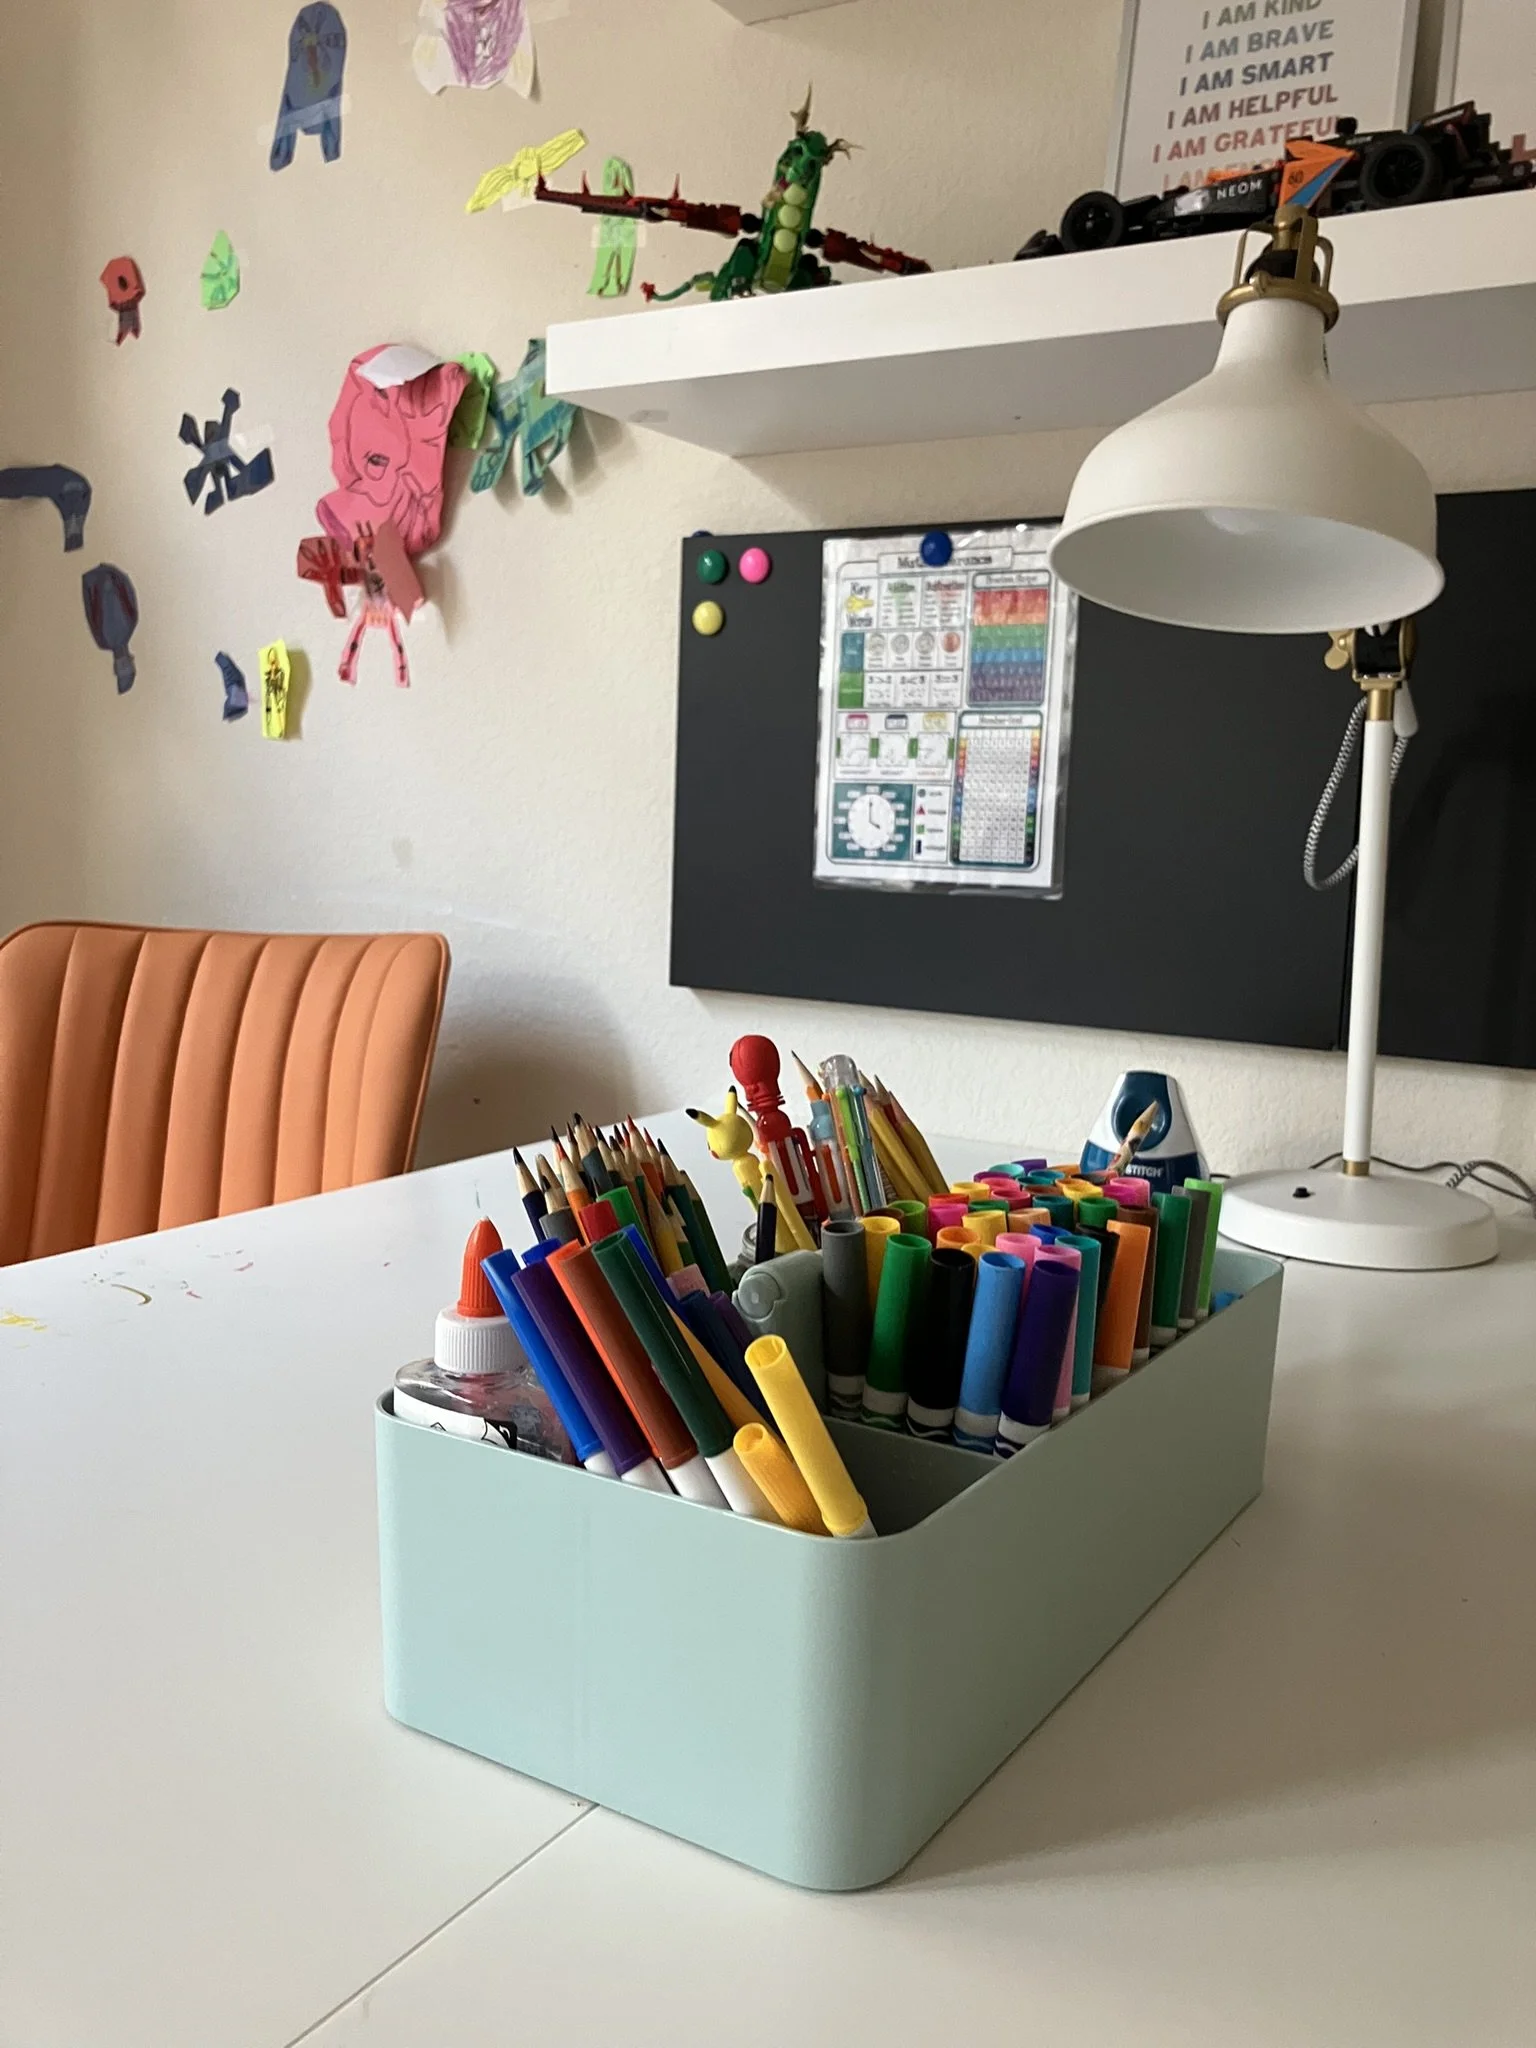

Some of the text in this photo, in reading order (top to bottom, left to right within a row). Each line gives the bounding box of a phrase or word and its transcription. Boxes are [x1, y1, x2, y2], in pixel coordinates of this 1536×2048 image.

[1202, 11, 1210, 30] I
[1216, 2, 1257, 27] AM
[1185, 19, 1334, 64] I AM BRAVE
[1179, 51, 1334, 96] I AM SMART
[1167, 84, 1338, 129] I AM HELPFUL
[1153, 116, 1339, 163] I AM GRATEFU
[1217, 179, 1263, 200] NEOM
